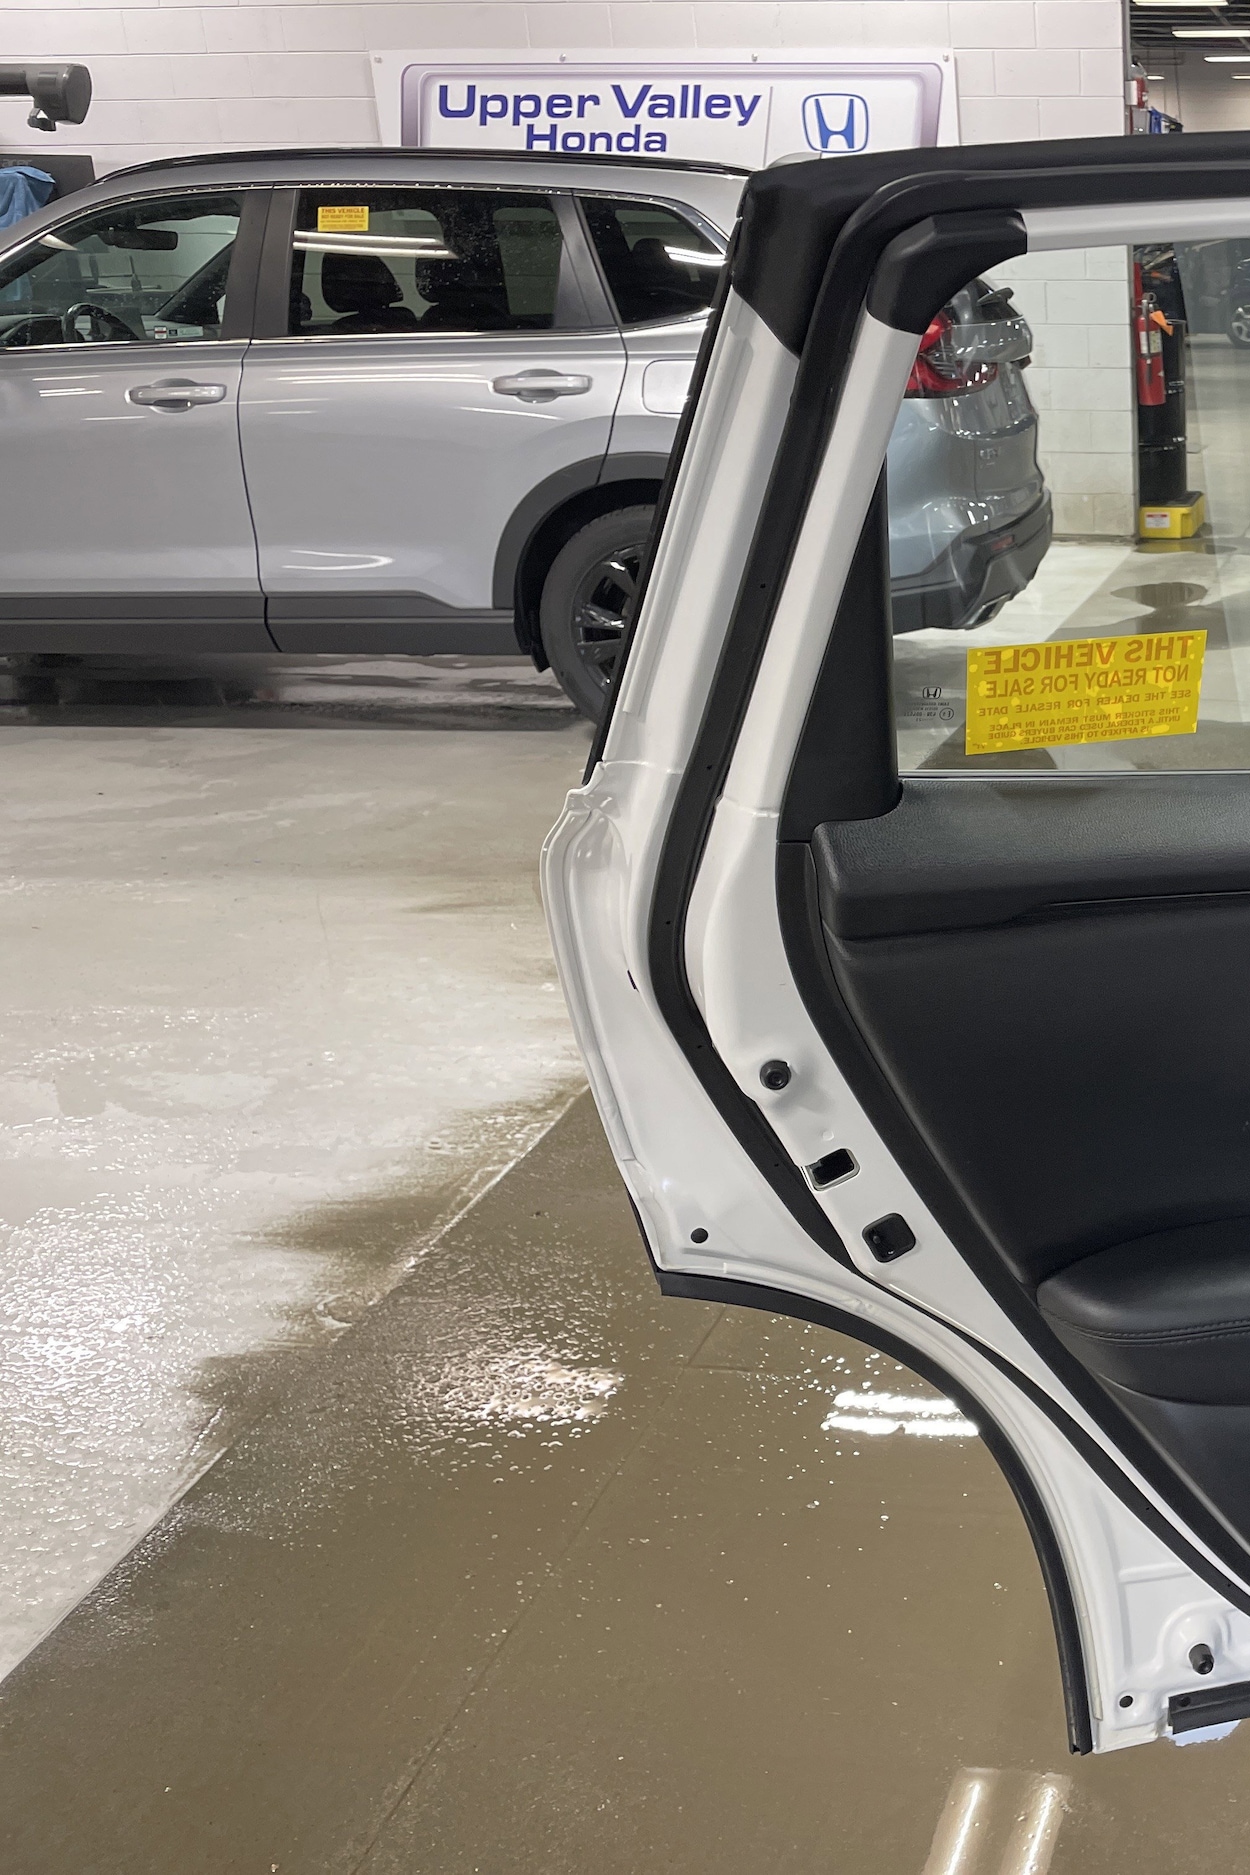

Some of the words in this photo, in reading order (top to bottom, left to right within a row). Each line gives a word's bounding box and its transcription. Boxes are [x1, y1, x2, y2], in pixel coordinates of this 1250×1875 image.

[439, 85, 600, 126] Upper
[611, 84, 762, 126] Valley
[526, 124, 667, 152] Honda
